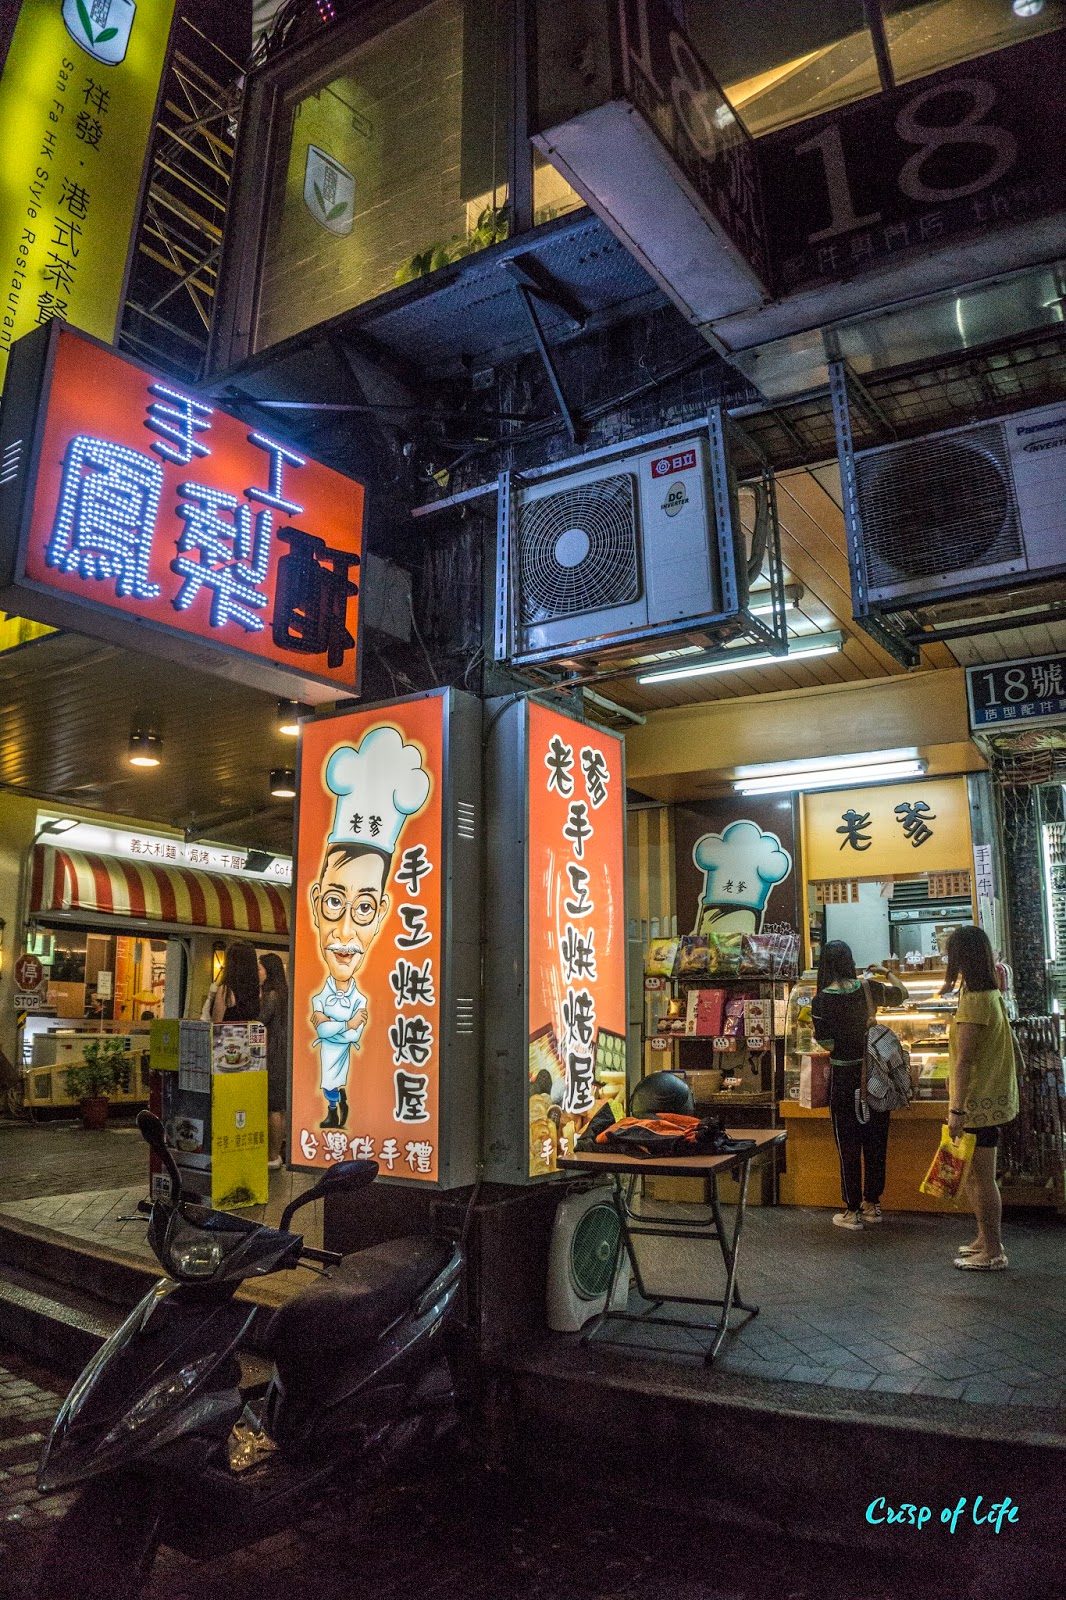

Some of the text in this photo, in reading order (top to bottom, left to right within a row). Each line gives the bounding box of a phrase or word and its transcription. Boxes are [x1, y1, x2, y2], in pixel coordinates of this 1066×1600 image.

[0, 58, 74, 353] San Fa HK Style Restaurant
[144, 382, 306, 519] 手工
[672, 453, 694, 469] 日立
[661, 498, 689, 510] INVERTER
[668, 491, 683, 503] DC
[45, 434, 361, 668] 鳳梨酥
[982, 663, 1066, 706] 18號
[545, 735, 610, 809] 老爹
[349, 813, 384, 838] 老爹
[835, 800, 936, 852] 老爹
[722, 878, 748, 895] 老爹
[21, 961, 38, 984] 停
[560, 800, 597, 1113] 手工烘焙屋
[14, 996, 39, 1007] STOP
[389, 844, 435, 1125] 手工烘焙屋
[299, 1127, 433, 1174] 台灣伴手禮
